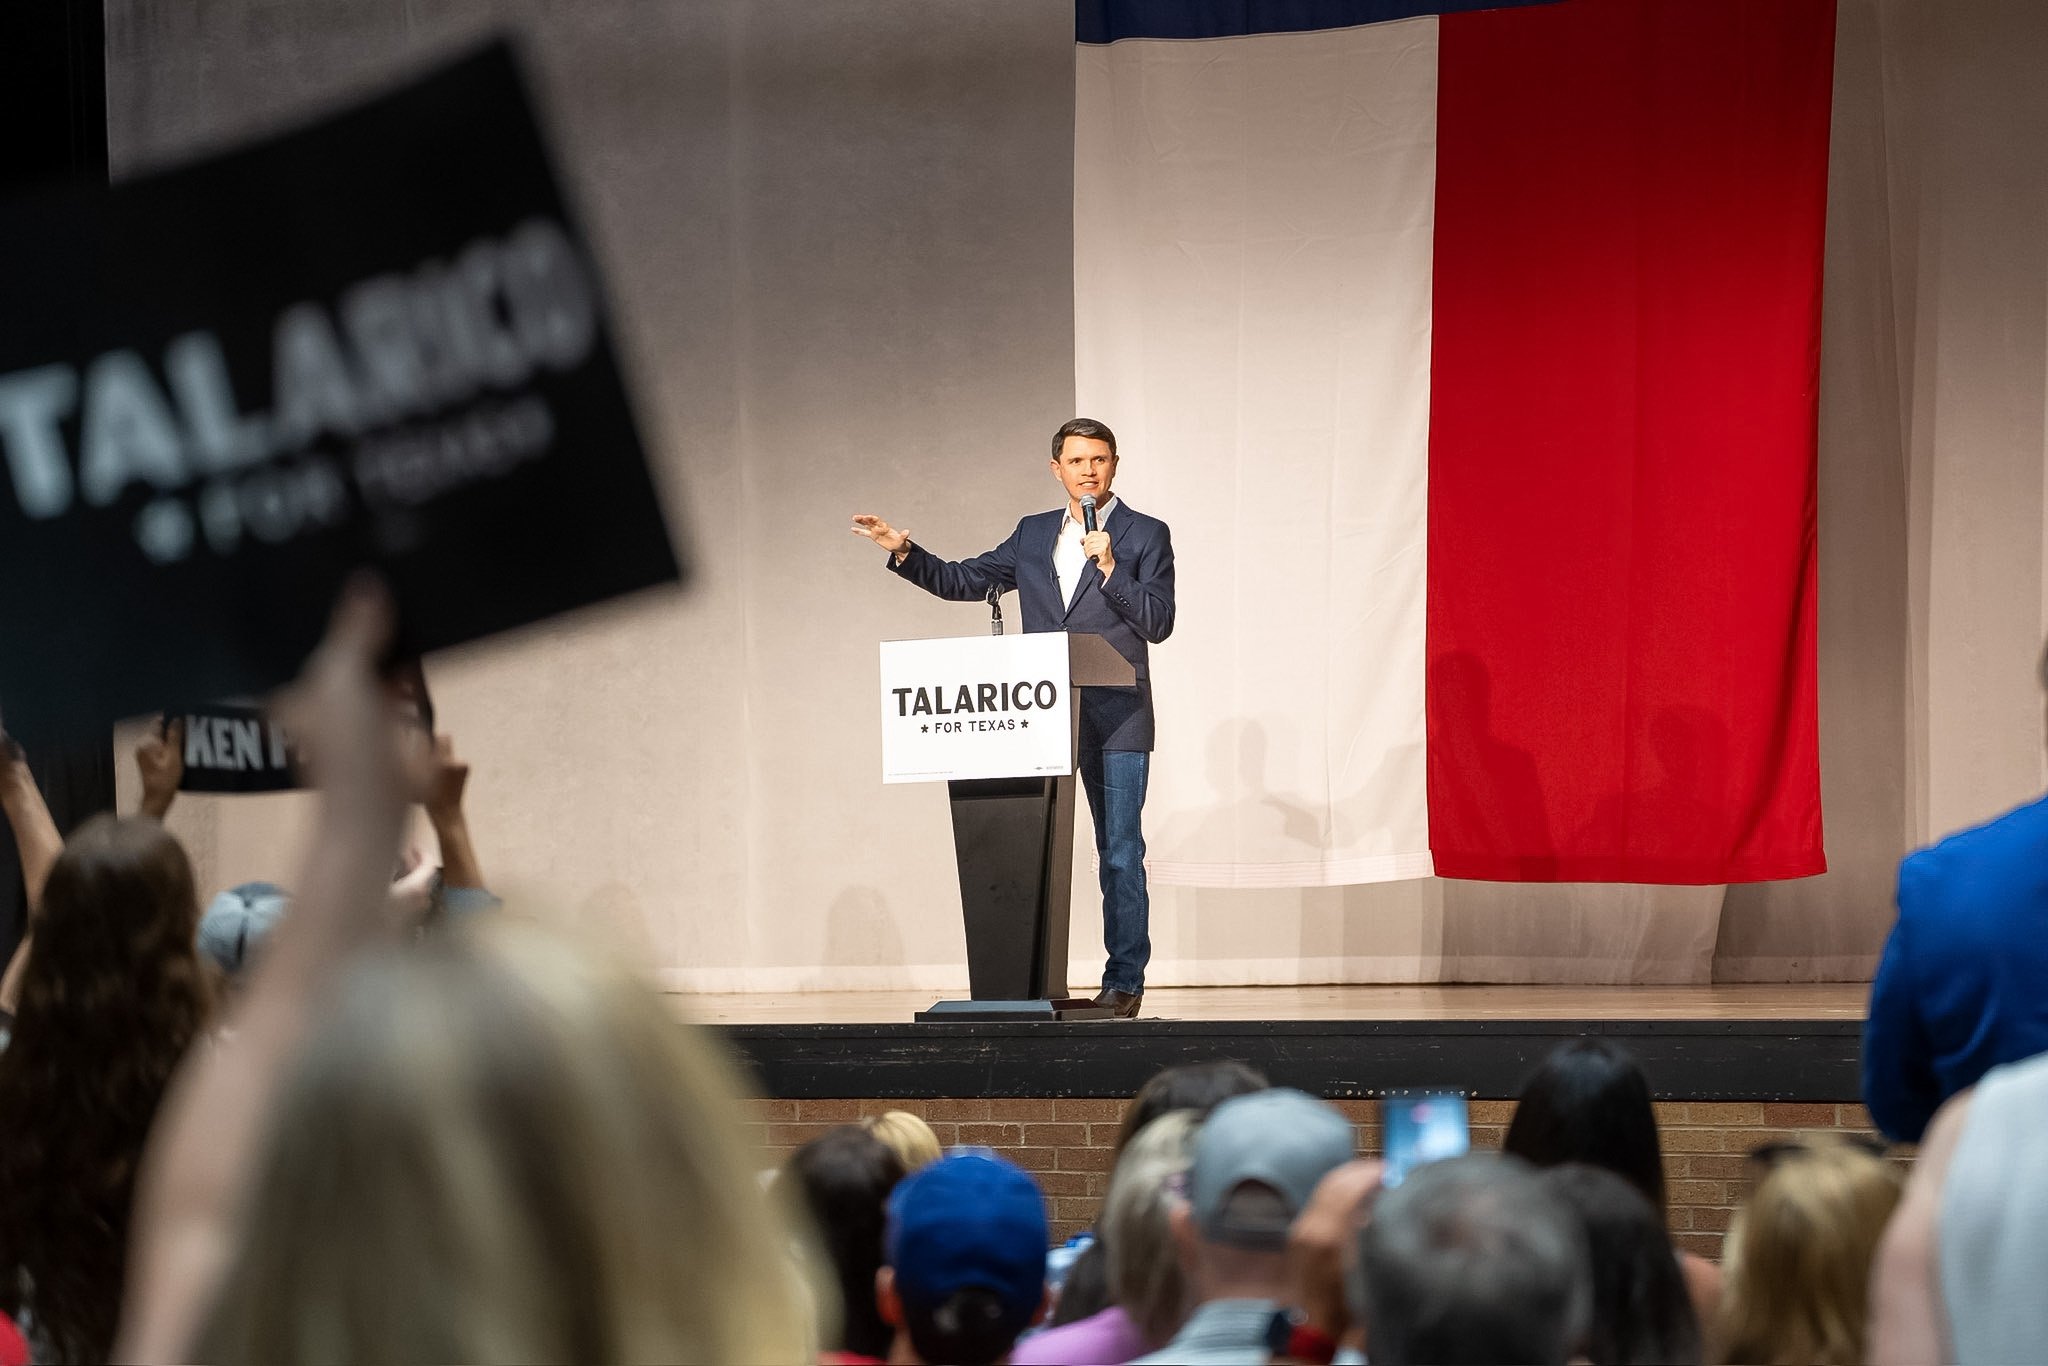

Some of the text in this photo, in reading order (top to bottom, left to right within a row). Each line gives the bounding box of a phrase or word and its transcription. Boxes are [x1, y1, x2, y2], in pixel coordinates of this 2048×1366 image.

[892, 680, 1057, 717] TALARICO
[184, 714, 265, 772] KEN
[935, 719, 1016, 734] FOR TEXAS
